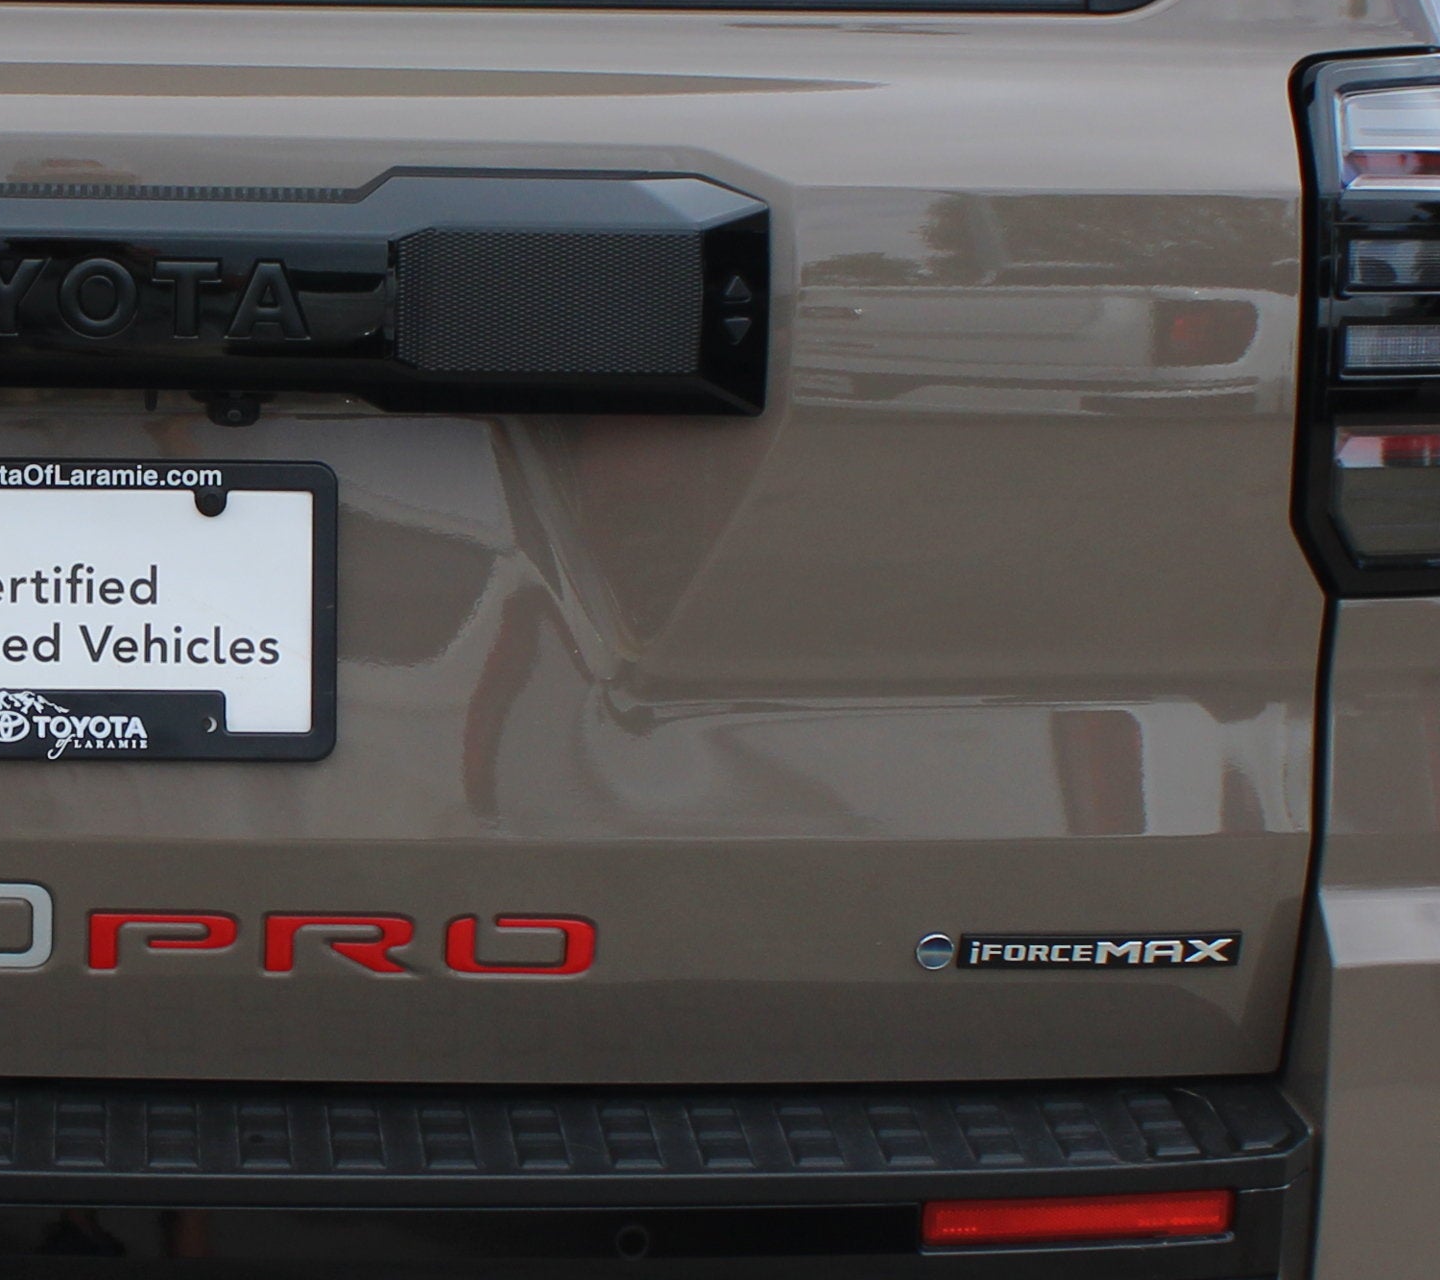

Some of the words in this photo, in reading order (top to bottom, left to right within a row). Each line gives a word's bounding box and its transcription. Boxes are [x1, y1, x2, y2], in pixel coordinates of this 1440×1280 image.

[78, 622, 281, 665] Vehicles
[32, 715, 148, 739] TOYOTA
[74, 739, 148, 749] LARAMIE
[87, 912, 594, 977] PRO
